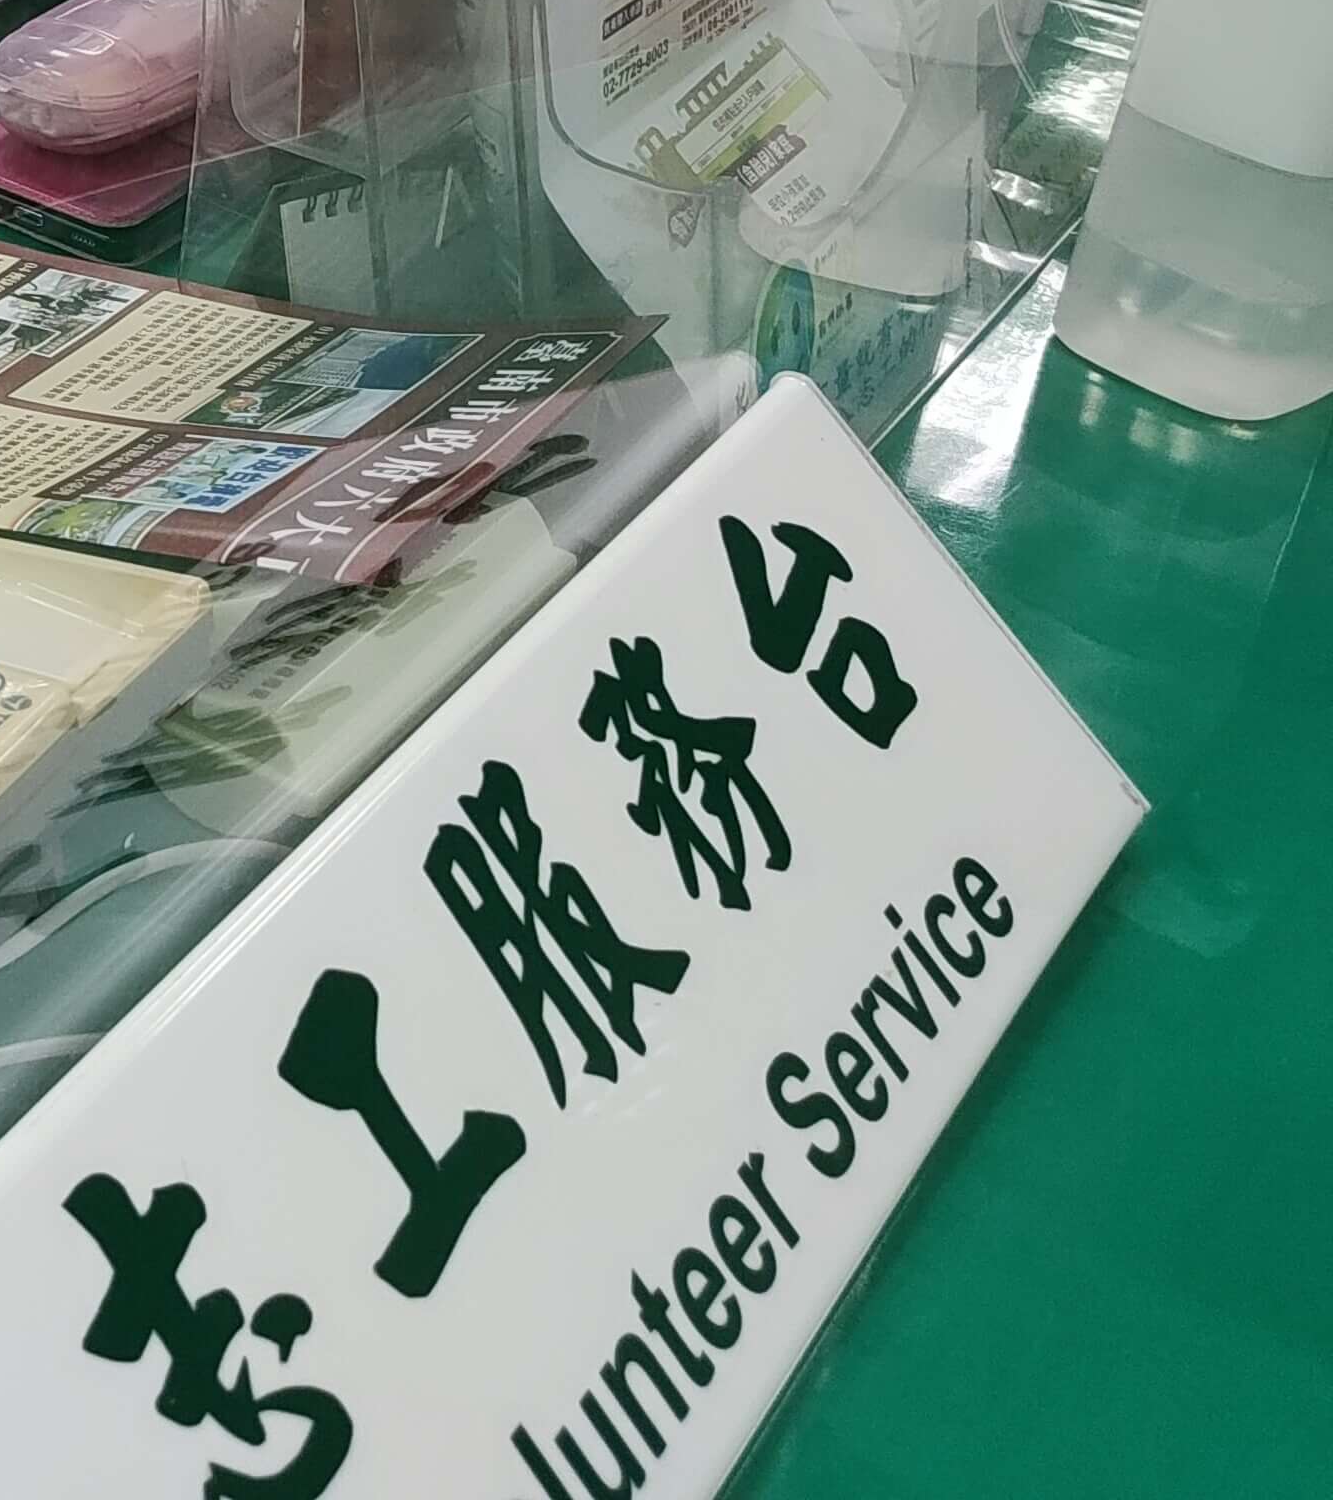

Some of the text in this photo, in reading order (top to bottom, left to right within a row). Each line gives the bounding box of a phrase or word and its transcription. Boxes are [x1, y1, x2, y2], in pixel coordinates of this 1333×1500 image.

[62, 513, 920, 1500] 志工服務台
[509, 851, 1018, 1500] lunteer Service
